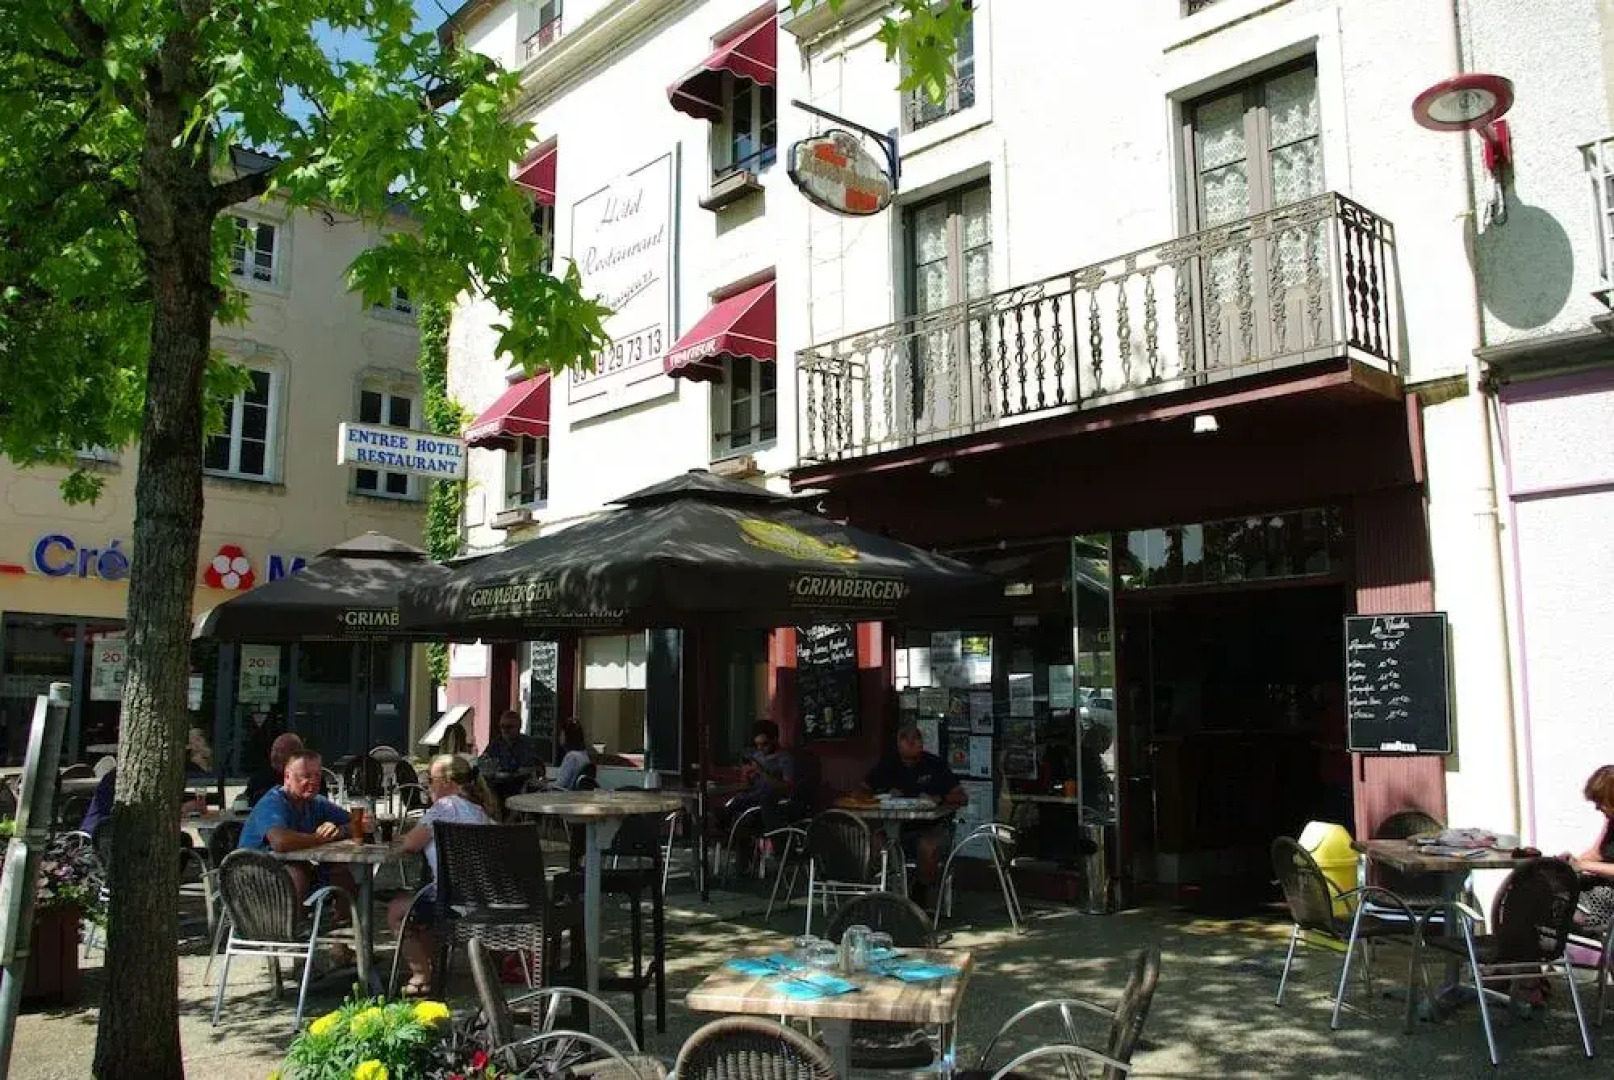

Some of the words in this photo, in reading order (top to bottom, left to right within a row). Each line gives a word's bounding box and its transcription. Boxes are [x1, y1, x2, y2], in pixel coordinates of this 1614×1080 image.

[583, 223, 665, 276] Restaurant
[608, 343, 624, 371] 29
[627, 336, 643, 363] 73
[647, 328, 662, 356] 13
[348, 429, 408, 450] ENTREE
[416, 439, 462, 458] HOTEL
[356, 448, 458, 474] RESTAURANT
[33, 534, 130, 581] Cré
[470, 581, 555, 608] GRIMBERGEN
[796, 575, 904, 600] GRIMBERGEN
[345, 611, 400, 626] GRIMB
